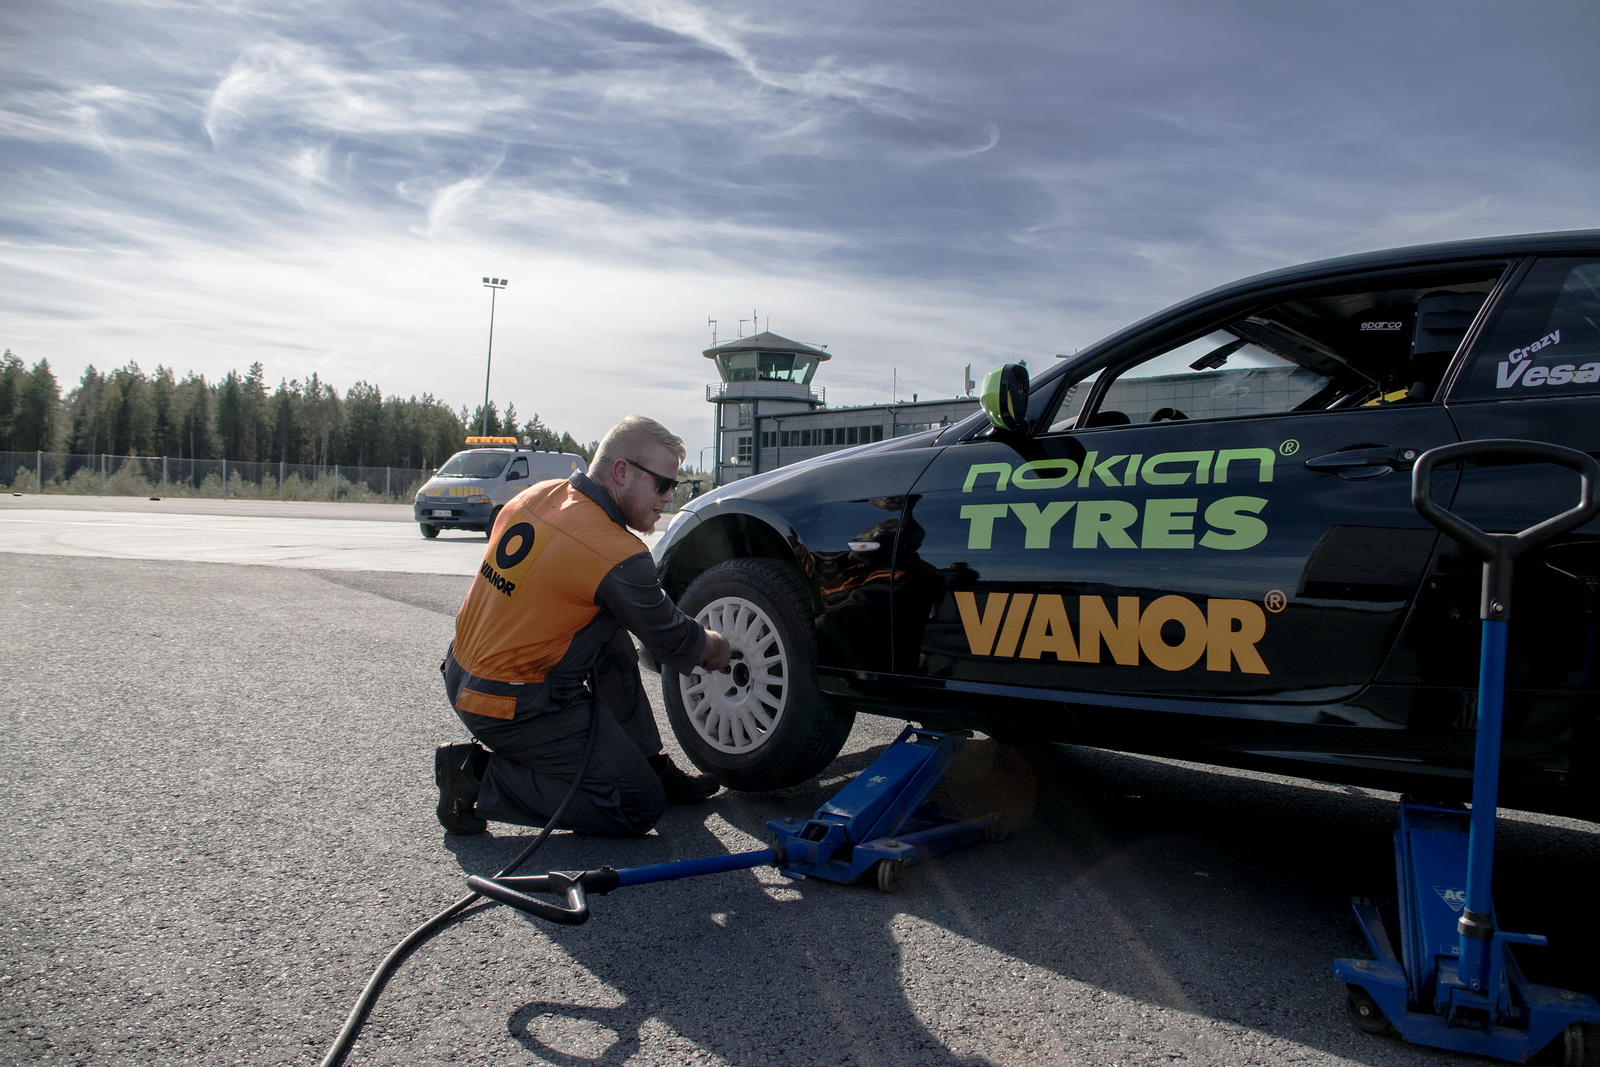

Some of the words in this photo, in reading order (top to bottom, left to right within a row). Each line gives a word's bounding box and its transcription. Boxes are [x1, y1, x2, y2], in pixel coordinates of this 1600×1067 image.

[1360, 321, 1403, 331] sparco
[1508, 329, 1561, 364] Crazy
[1495, 359, 1600, 389] Vesa
[959, 495, 1269, 550] TYRES
[480, 559, 516, 598] VIANOR
[954, 591, 1271, 675] VIANOR
